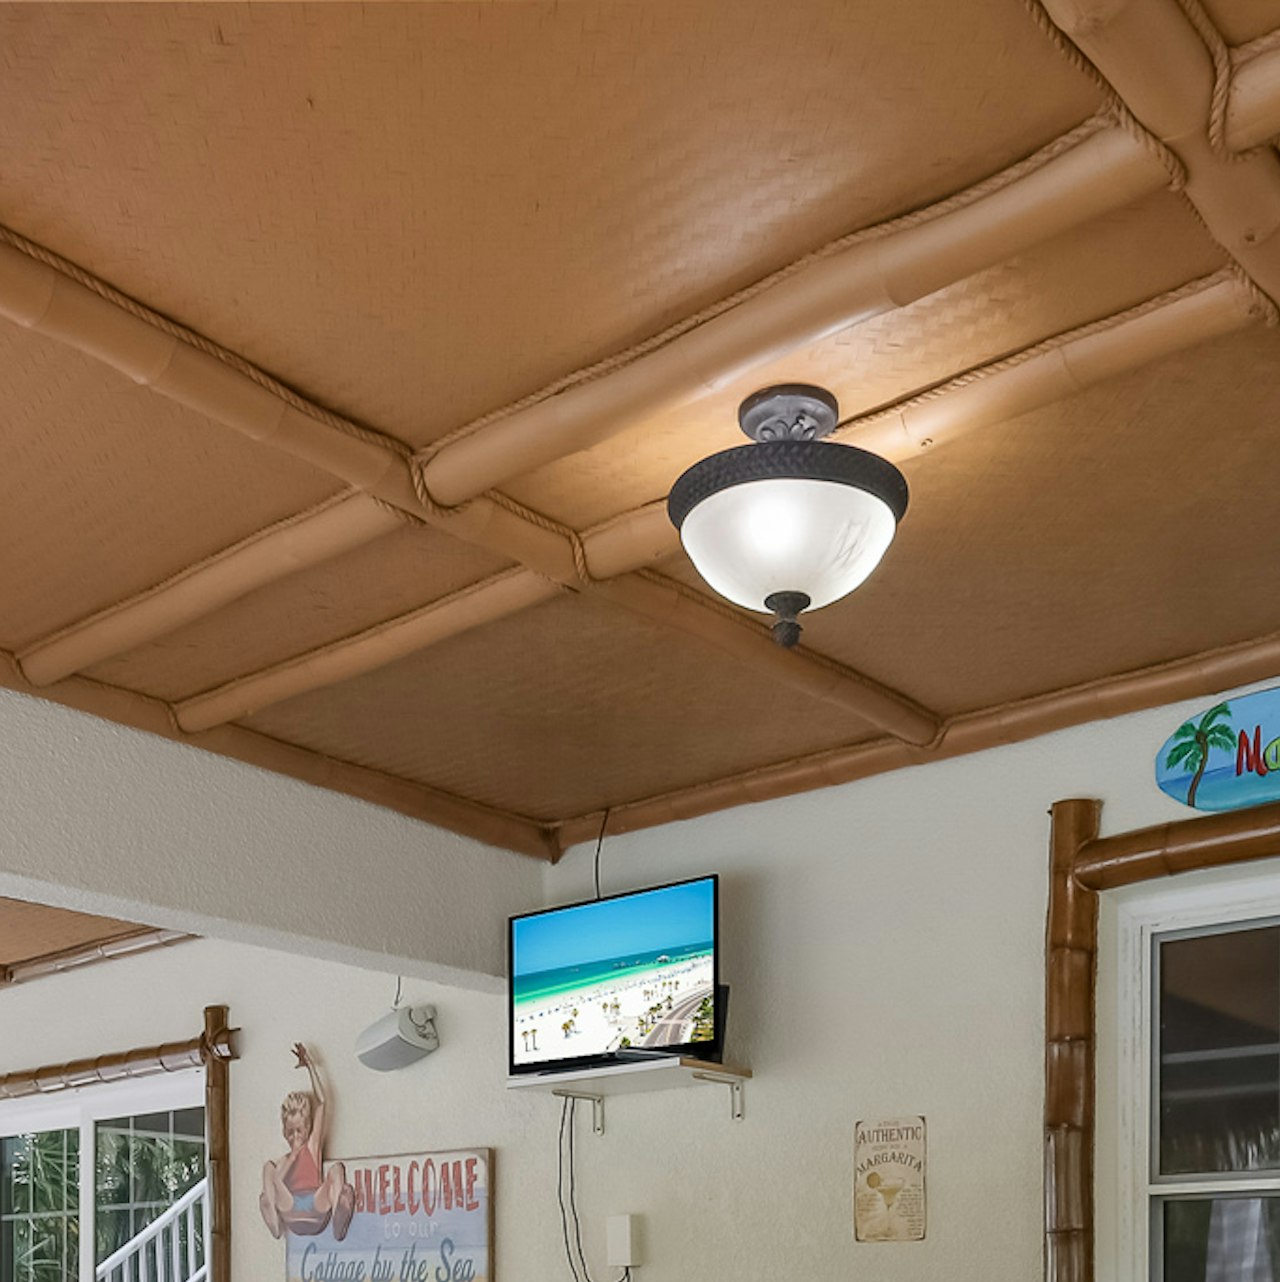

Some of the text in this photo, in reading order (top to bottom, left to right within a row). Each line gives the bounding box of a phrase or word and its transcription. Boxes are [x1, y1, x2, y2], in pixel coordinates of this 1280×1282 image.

[857, 1126, 922, 1144] AUTHENTIC
[354, 1157, 480, 1217] WELCOME
[383, 1218, 439, 1240] to our
